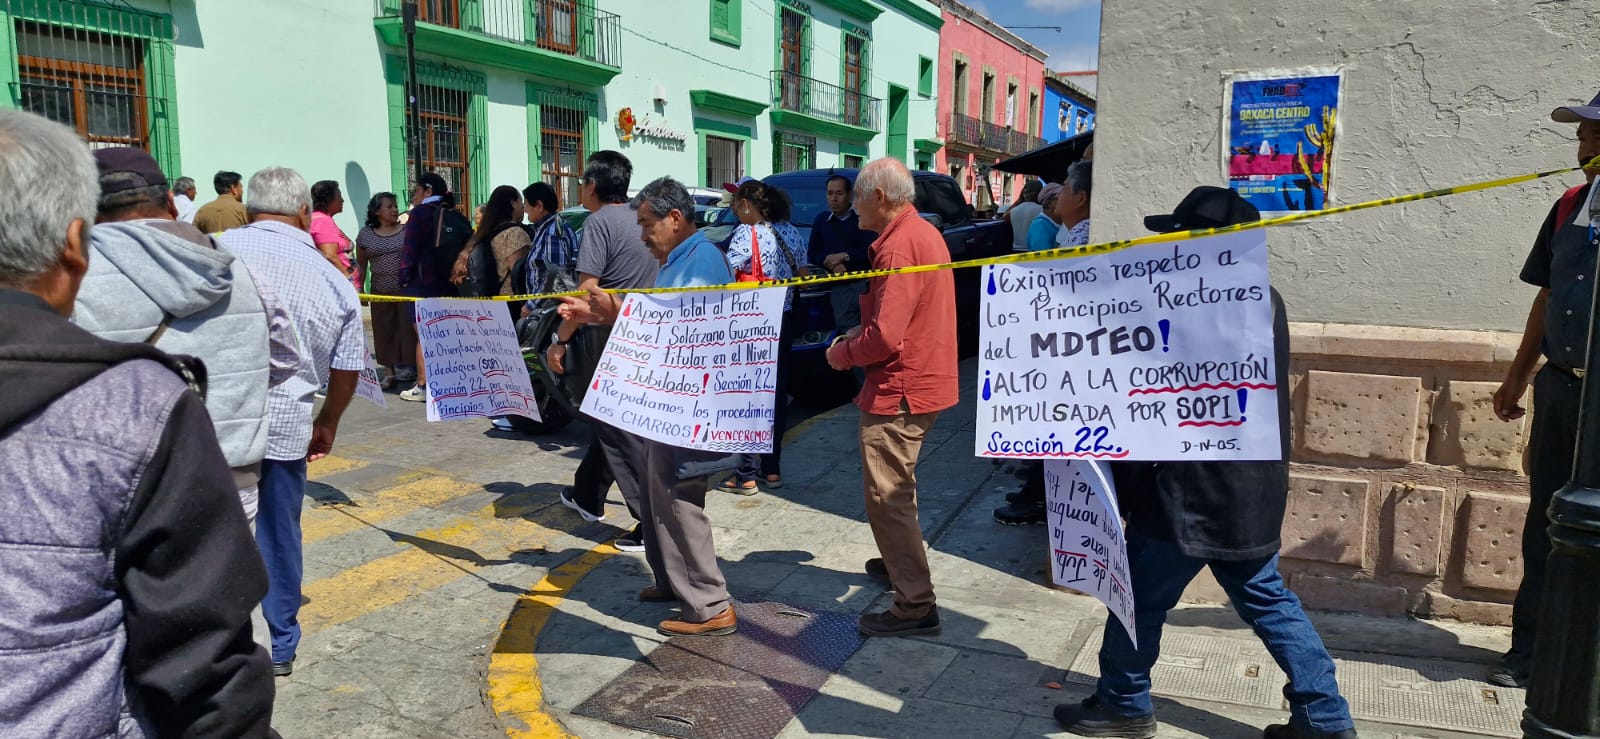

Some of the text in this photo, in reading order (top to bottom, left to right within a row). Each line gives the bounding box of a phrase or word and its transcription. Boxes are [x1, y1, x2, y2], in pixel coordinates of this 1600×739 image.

[1240, 106, 1311, 121] OAXACA CENTRO
[987, 264, 1097, 298] ¡Exigimos
[1111, 245, 1201, 284] respeto
[1218, 250, 1241, 266] a
[623, 292, 759, 324] ¡Apoyo total al Prof.
[986, 277, 1263, 328] los Principios Rectores
[455, 322, 465, 336] de
[467, 322, 477, 336] la
[613, 319, 778, 345] Novel Solórzano Guzmán,
[984, 318, 1171, 361] del MDTEO!
[424, 347, 434, 359] de
[436, 340, 484, 358] Orientación
[609, 341, 651, 361] nuevo
[712, 354, 726, 364] en
[731, 348, 741, 364] el
[746, 343, 772, 360] Nivel
[428, 359, 477, 381] Ideológica
[600, 358, 774, 395] de Jubilados! Sección 22.
[981, 353, 1269, 401] ¡ALTO A LA CORRUPCIÓN
[429, 381, 466, 398] Sección
[591, 375, 684, 414] ¡Repudiamos
[693, 400, 709, 418] los
[432, 401, 484, 416] Principios
[1127, 400, 1167, 426] POR
[1177, 387, 1248, 423] SOPI!
[621, 410, 701, 443] CHARROS!
[987, 425, 1122, 456] Sección 22.
[1070, 480, 1095, 505] del
[1054, 526, 1064, 549] la
[1081, 535, 1109, 571] tiene
[1093, 564, 1106, 592] de
